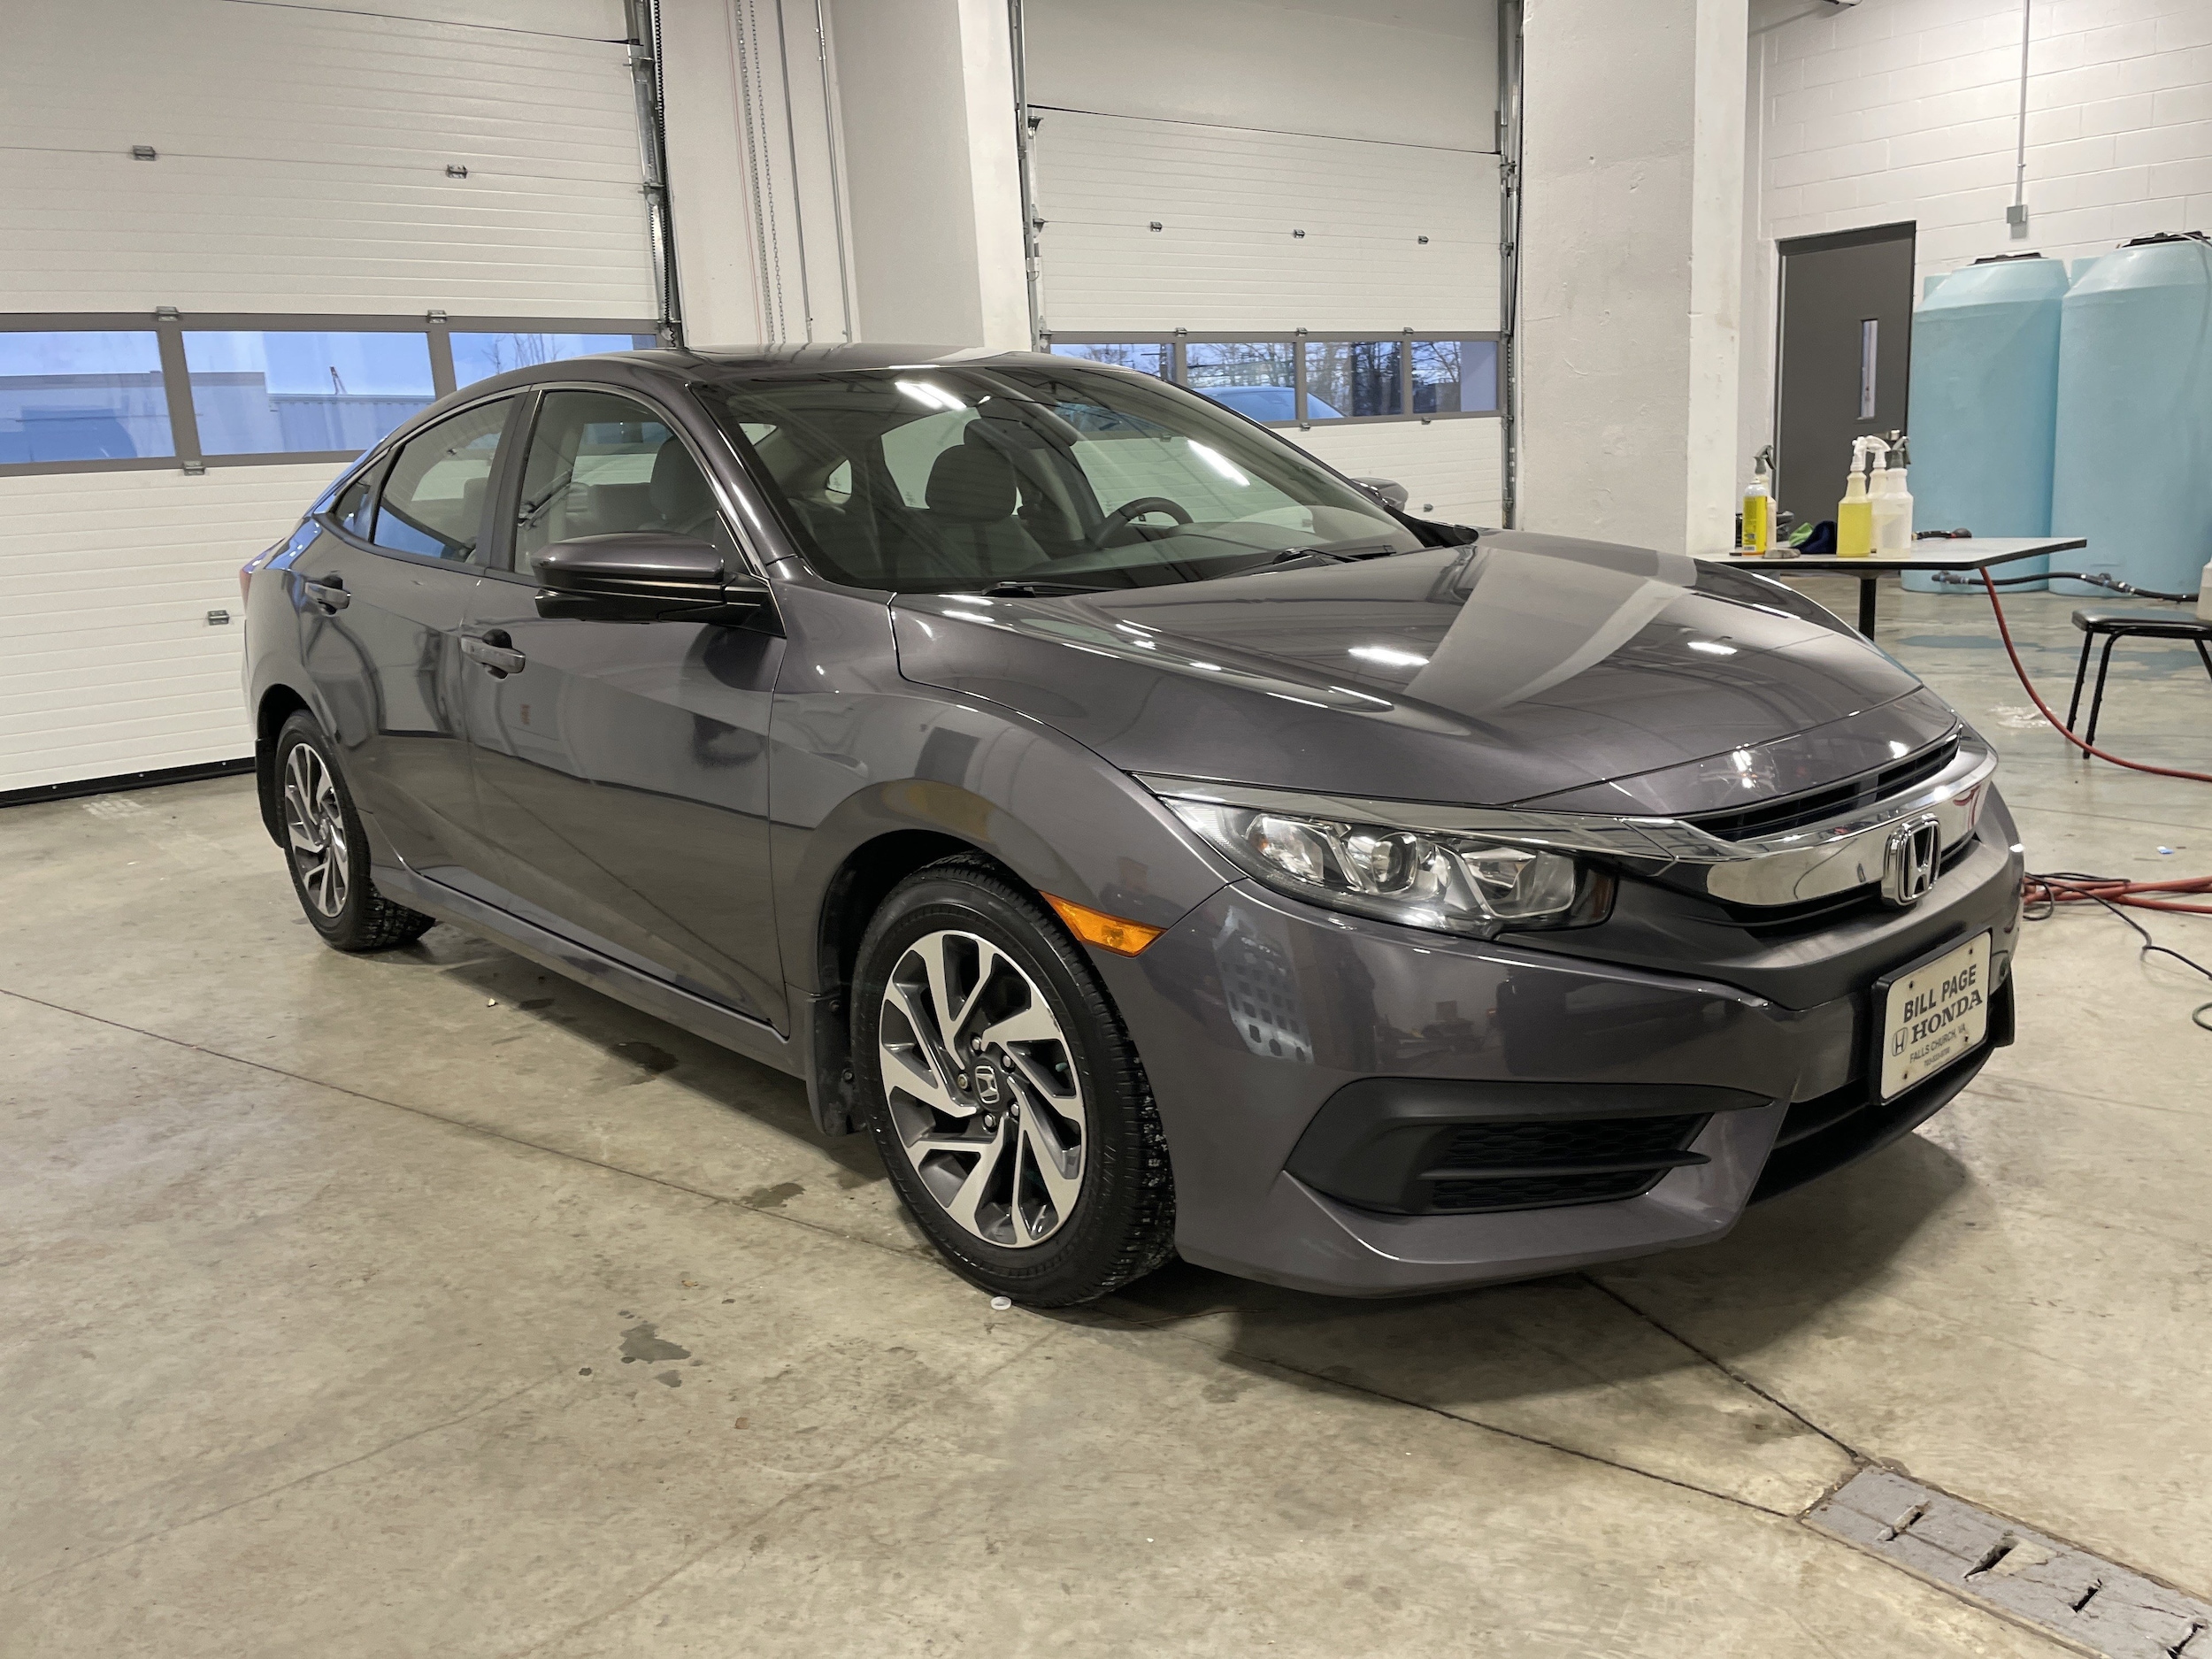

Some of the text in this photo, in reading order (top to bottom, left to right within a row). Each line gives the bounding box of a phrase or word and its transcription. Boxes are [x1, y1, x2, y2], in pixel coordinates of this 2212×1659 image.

[1903, 964, 1977, 1023] BILL PAGE
[1911, 989, 1983, 1044] HONDA
[1909, 1044, 1930, 1064] FALLS
